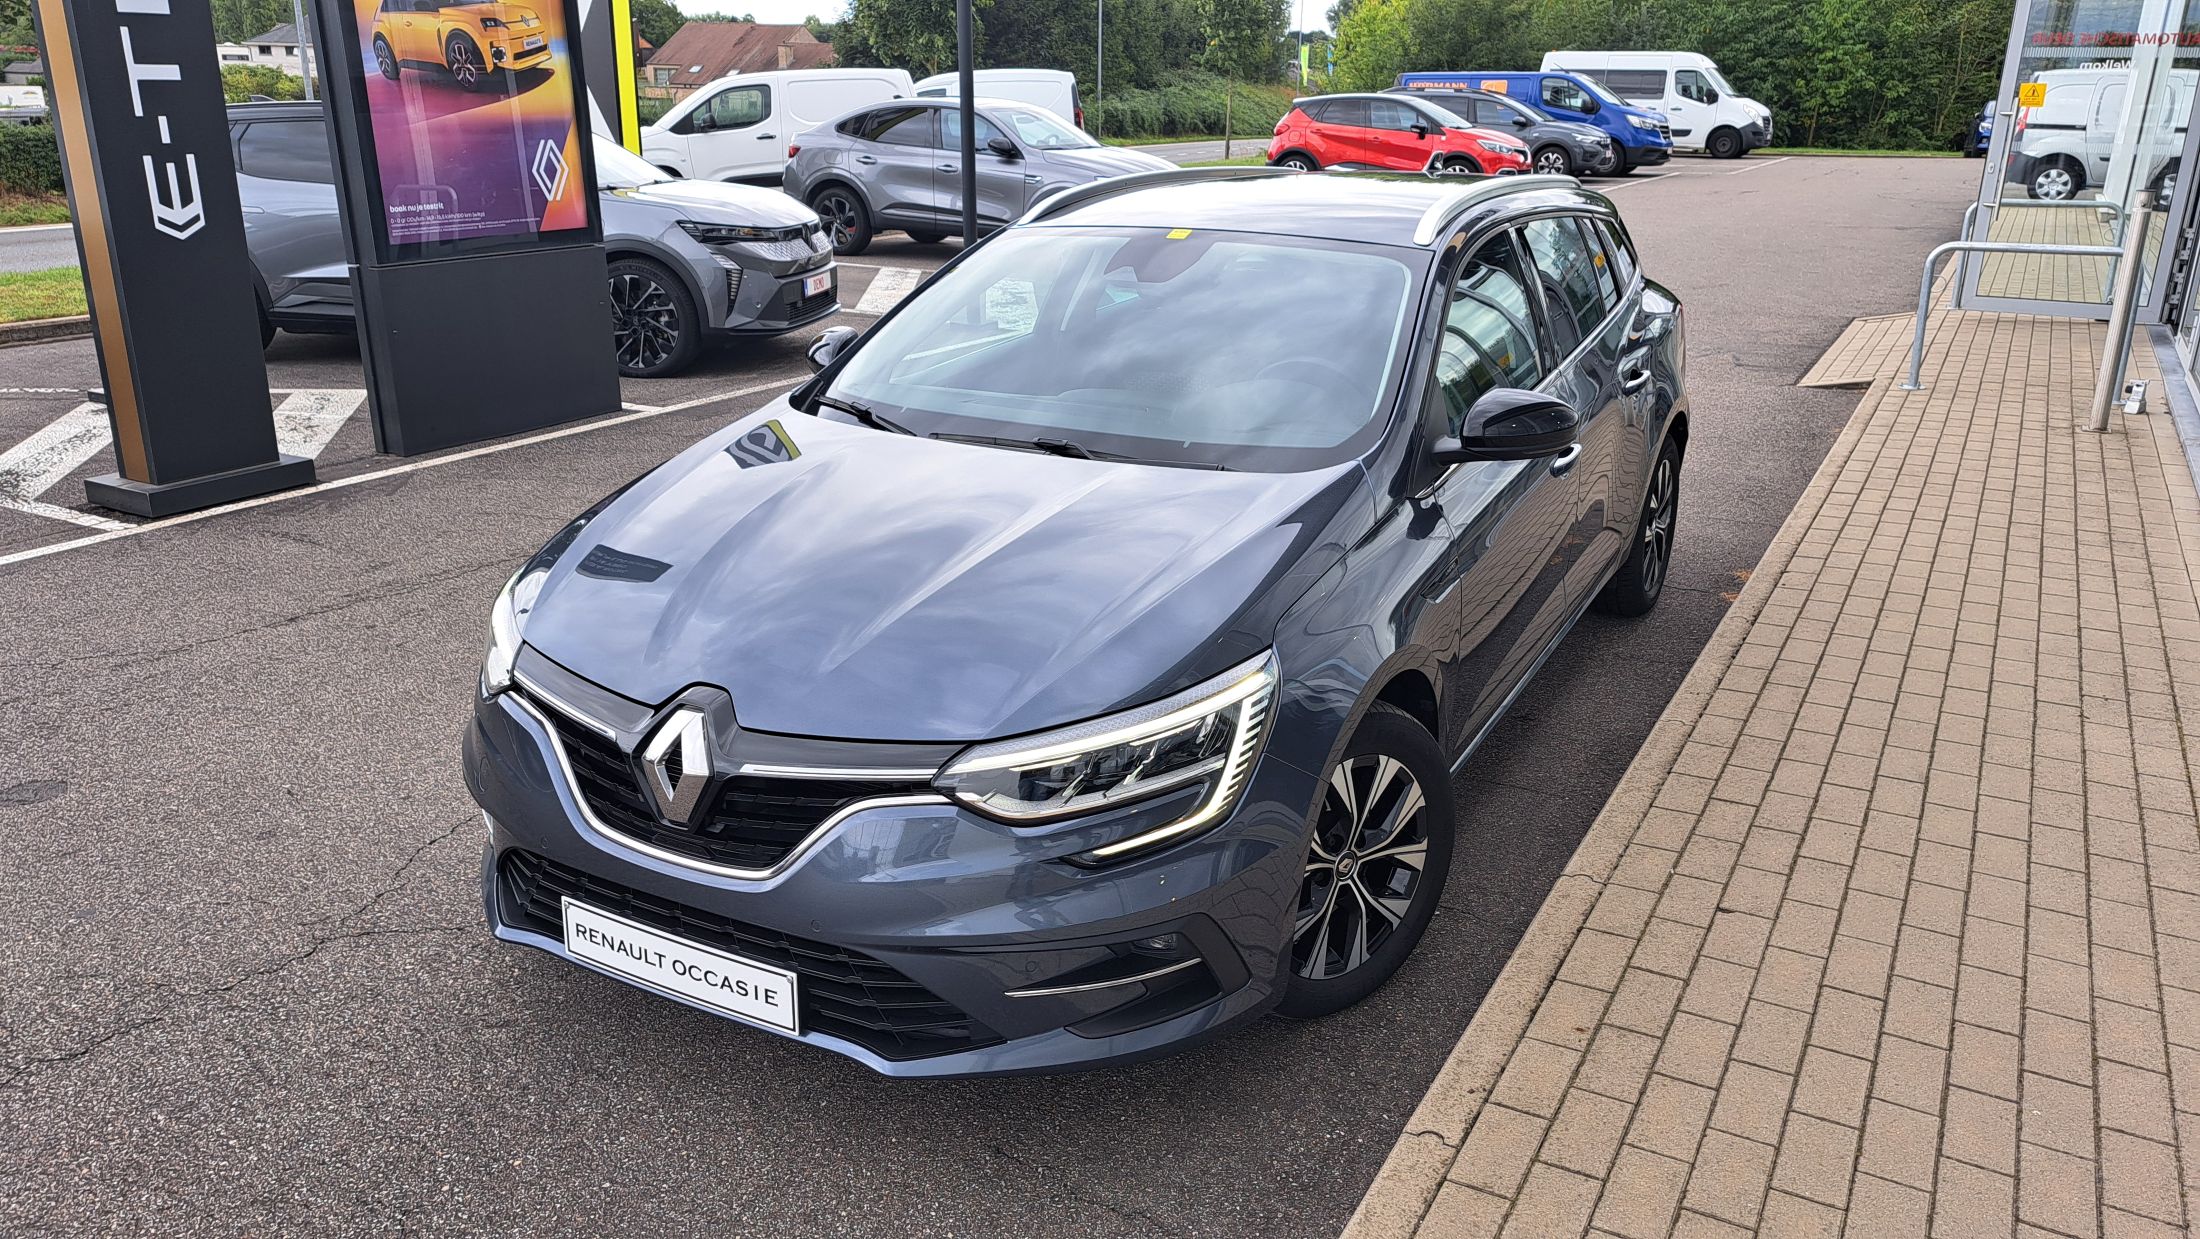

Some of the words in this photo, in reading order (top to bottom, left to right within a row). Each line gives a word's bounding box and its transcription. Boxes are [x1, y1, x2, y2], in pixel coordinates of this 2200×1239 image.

[407, 204, 416, 212] nu
[416, 203, 423, 213] je
[423, 201, 444, 210] testrit
[813, 276, 825, 291] DEMO
[574, 922, 667, 969] RENAULT
[672, 959, 779, 1008] OCCASIE
